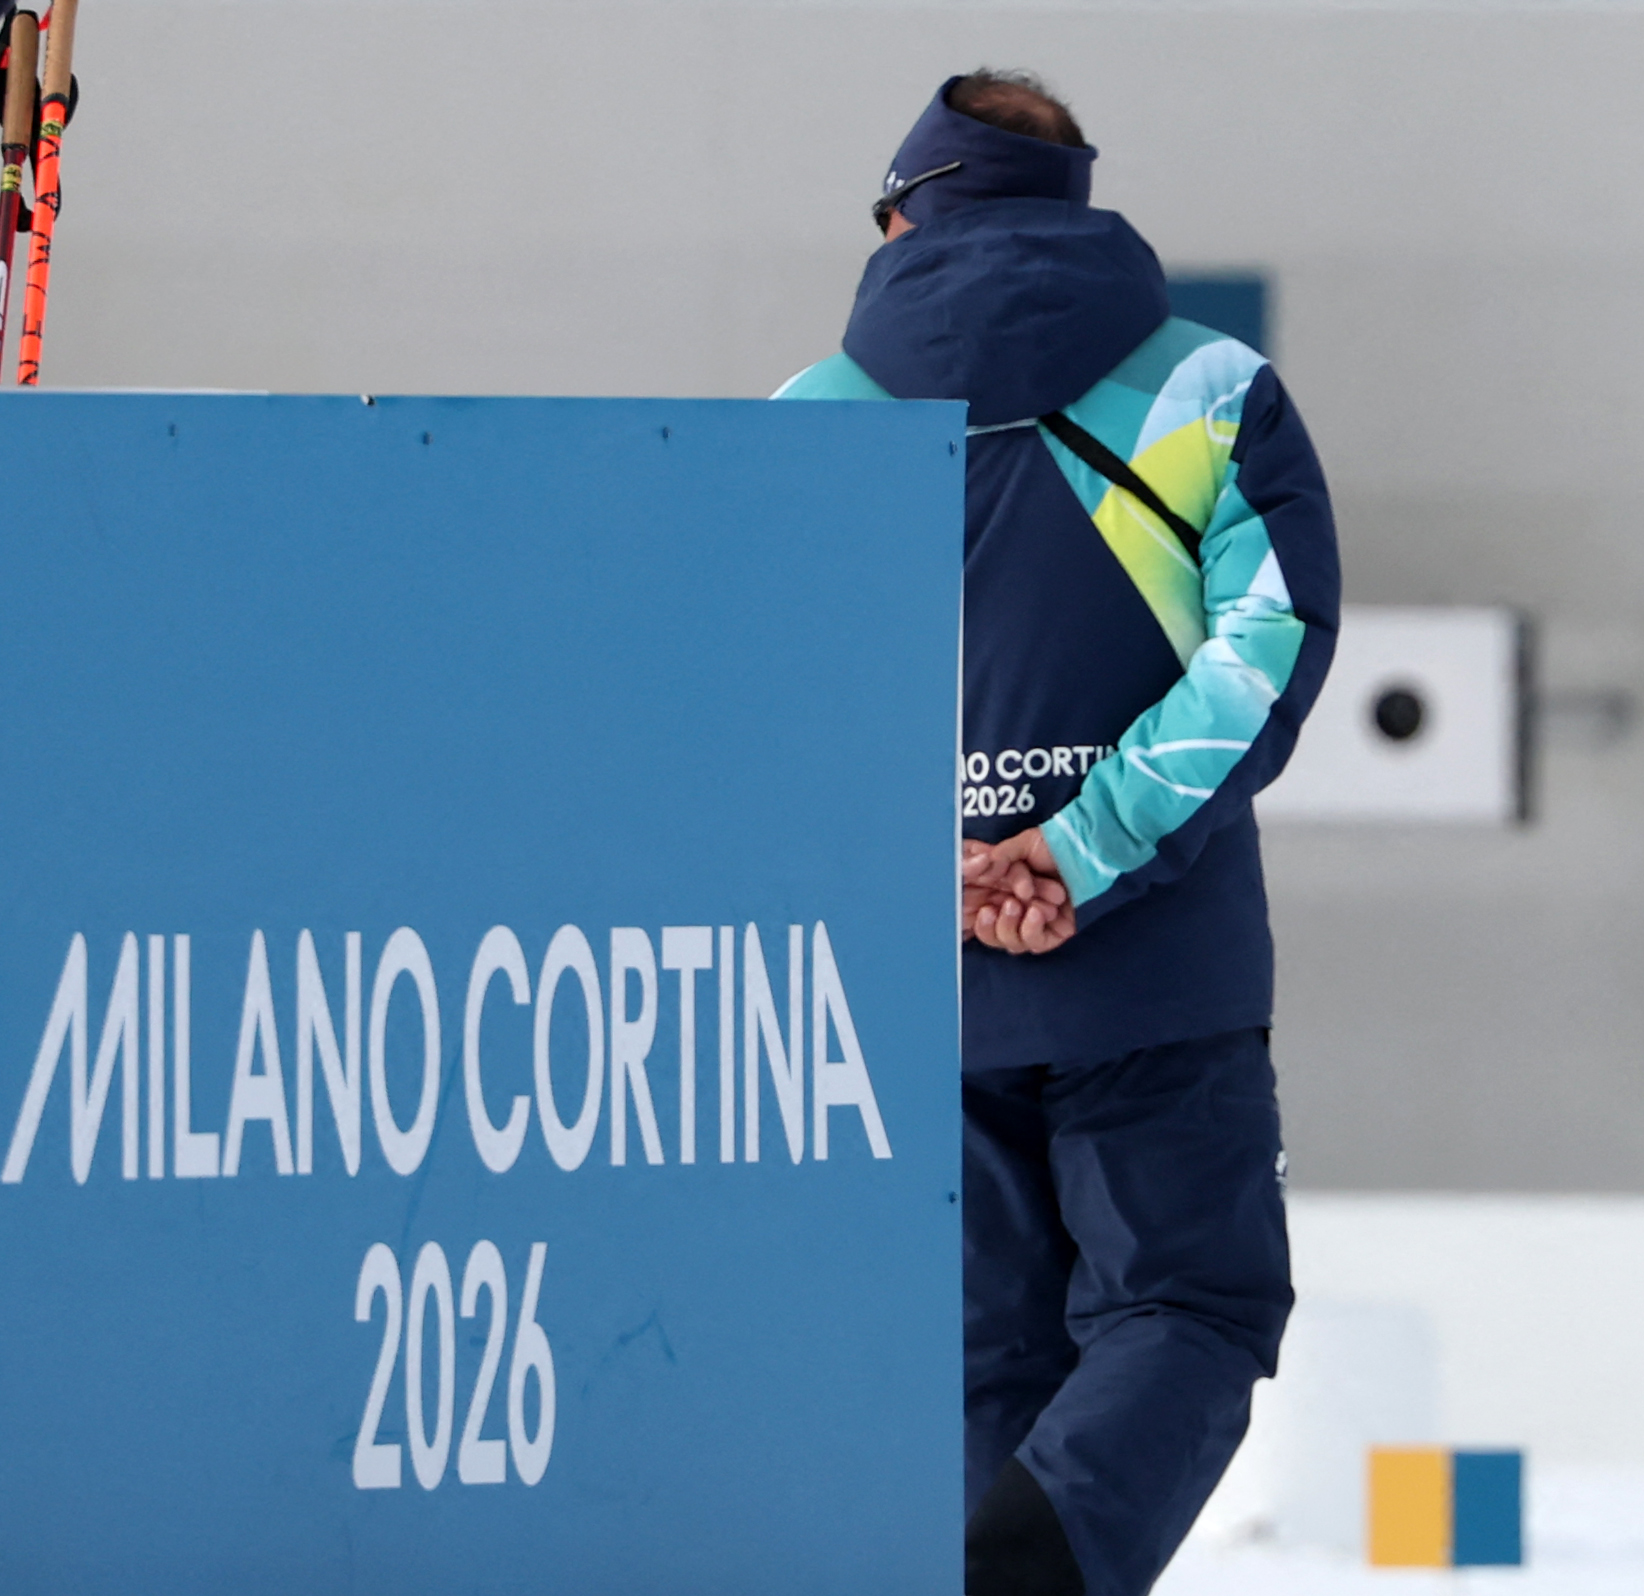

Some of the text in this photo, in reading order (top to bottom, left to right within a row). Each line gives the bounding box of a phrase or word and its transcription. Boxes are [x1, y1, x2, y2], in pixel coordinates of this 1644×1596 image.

[963, 783, 1036, 818] 2026
[0, 920, 894, 1186] MILANO CORTINA
[352, 1239, 557, 1491] 2026
